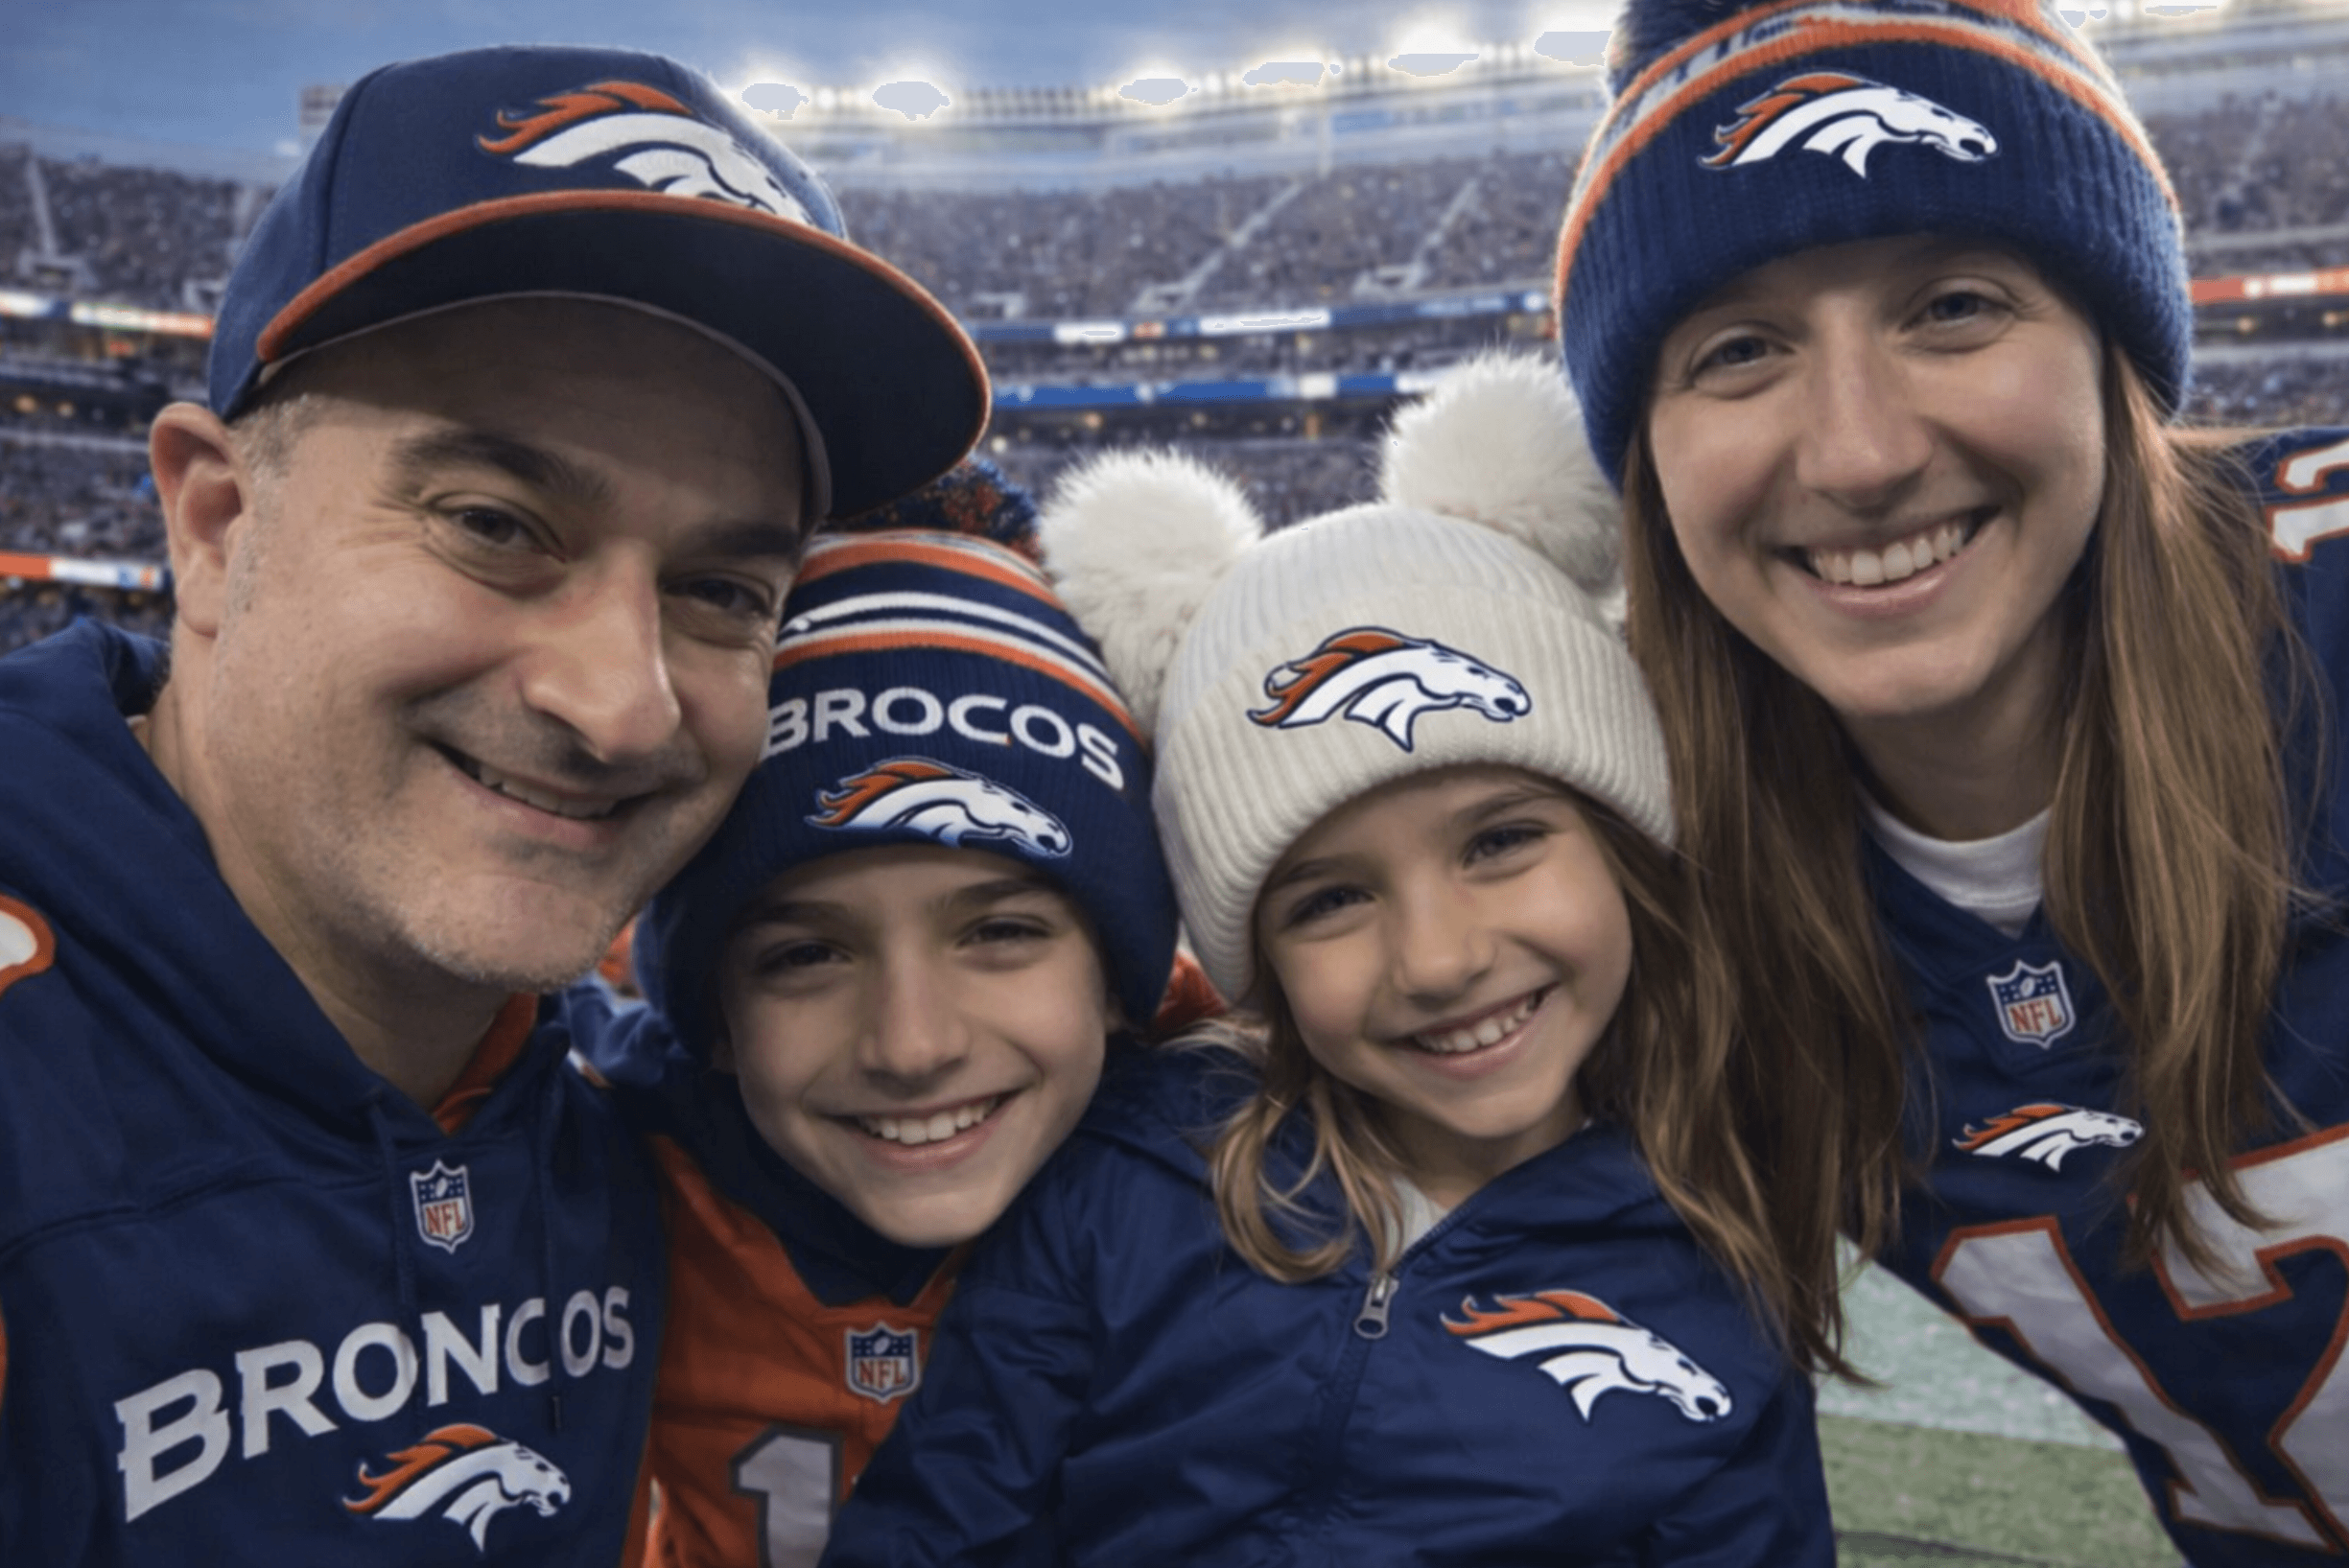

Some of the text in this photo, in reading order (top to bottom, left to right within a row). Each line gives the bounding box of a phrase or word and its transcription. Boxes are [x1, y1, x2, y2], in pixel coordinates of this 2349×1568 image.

[759, 687, 1124, 791] BROCOS
[2009, 997, 2063, 1033] NFL
[426, 1201, 466, 1236] NFL
[858, 1359, 906, 1389] NFL
[114, 1285, 635, 1524] BRONCOS
